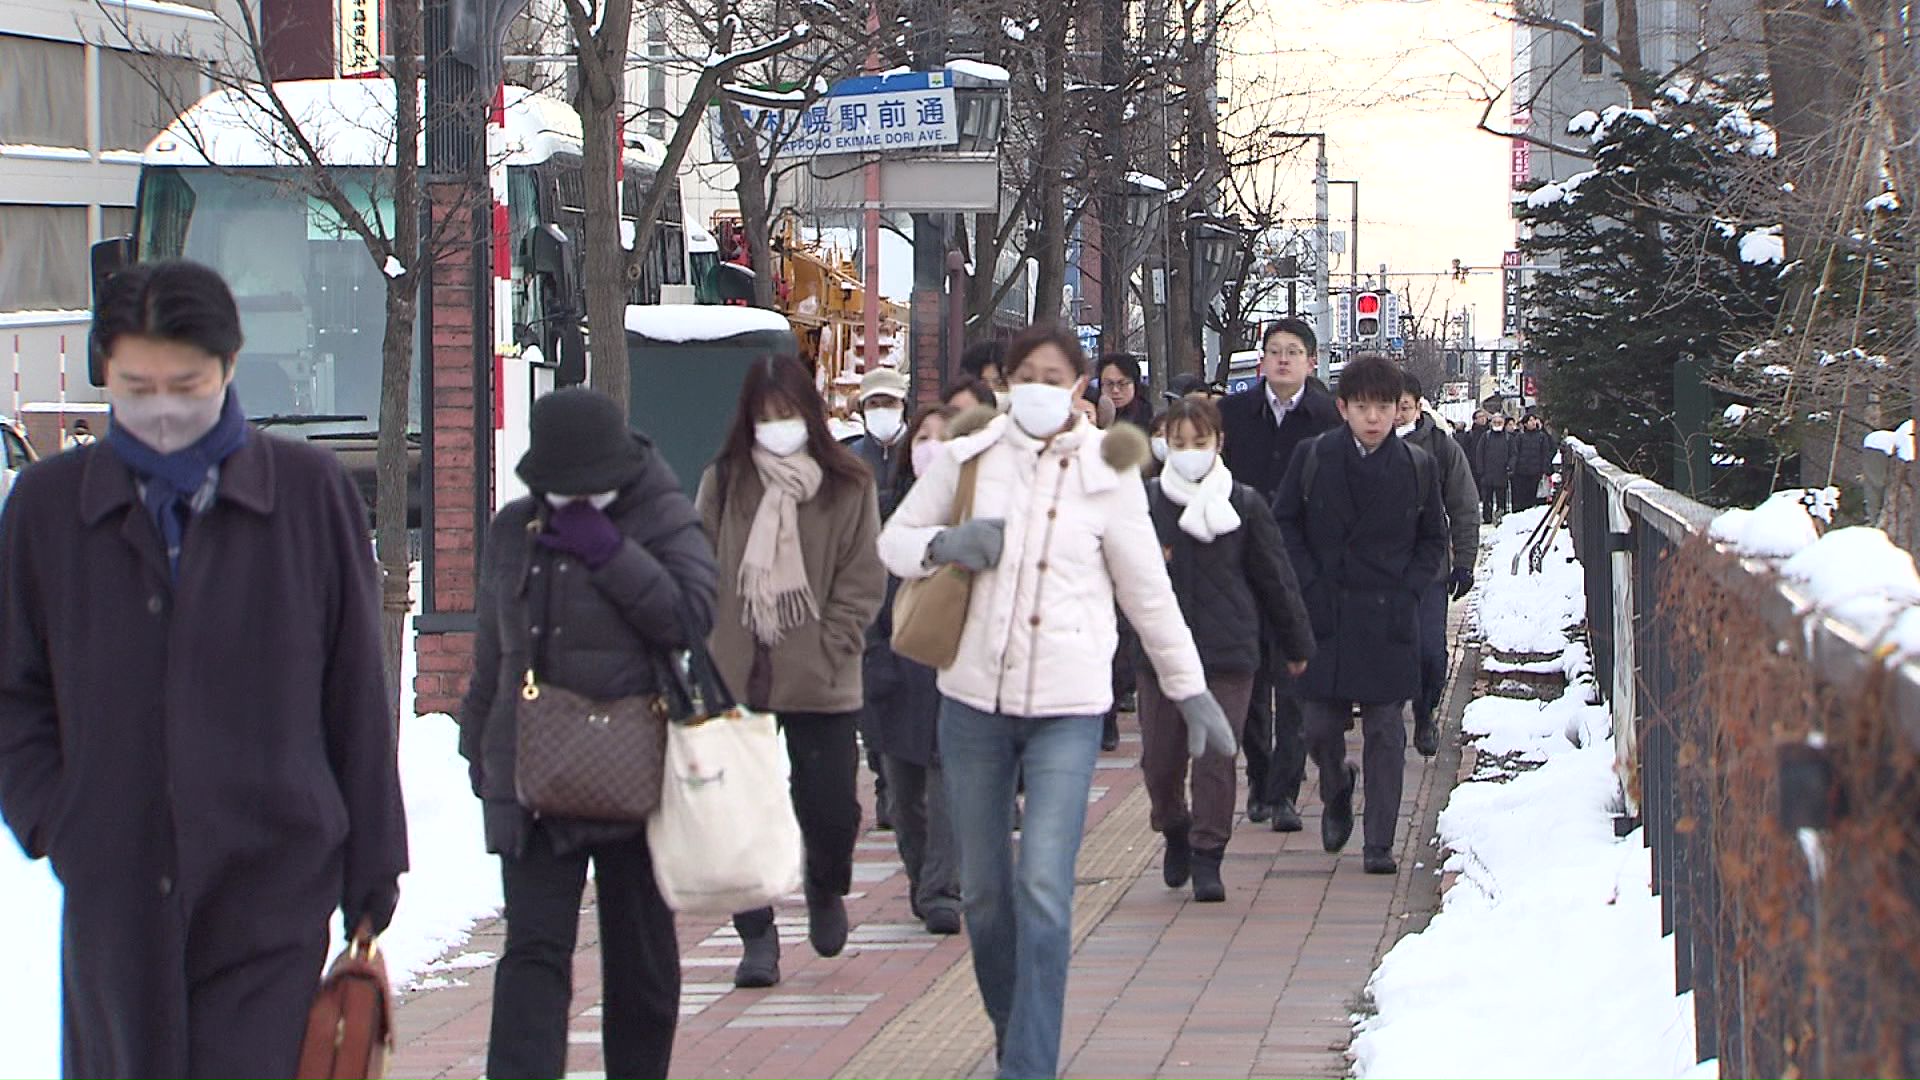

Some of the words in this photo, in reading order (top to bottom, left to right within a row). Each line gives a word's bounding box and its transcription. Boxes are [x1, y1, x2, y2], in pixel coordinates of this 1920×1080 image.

[764, 97, 946, 136] 札幌駅前通
[775, 137, 832, 153] APPORO
[836, 135, 881, 149] EKIMAE
[885, 132, 915, 145] DORI
[918, 129, 948, 142] AVE.
